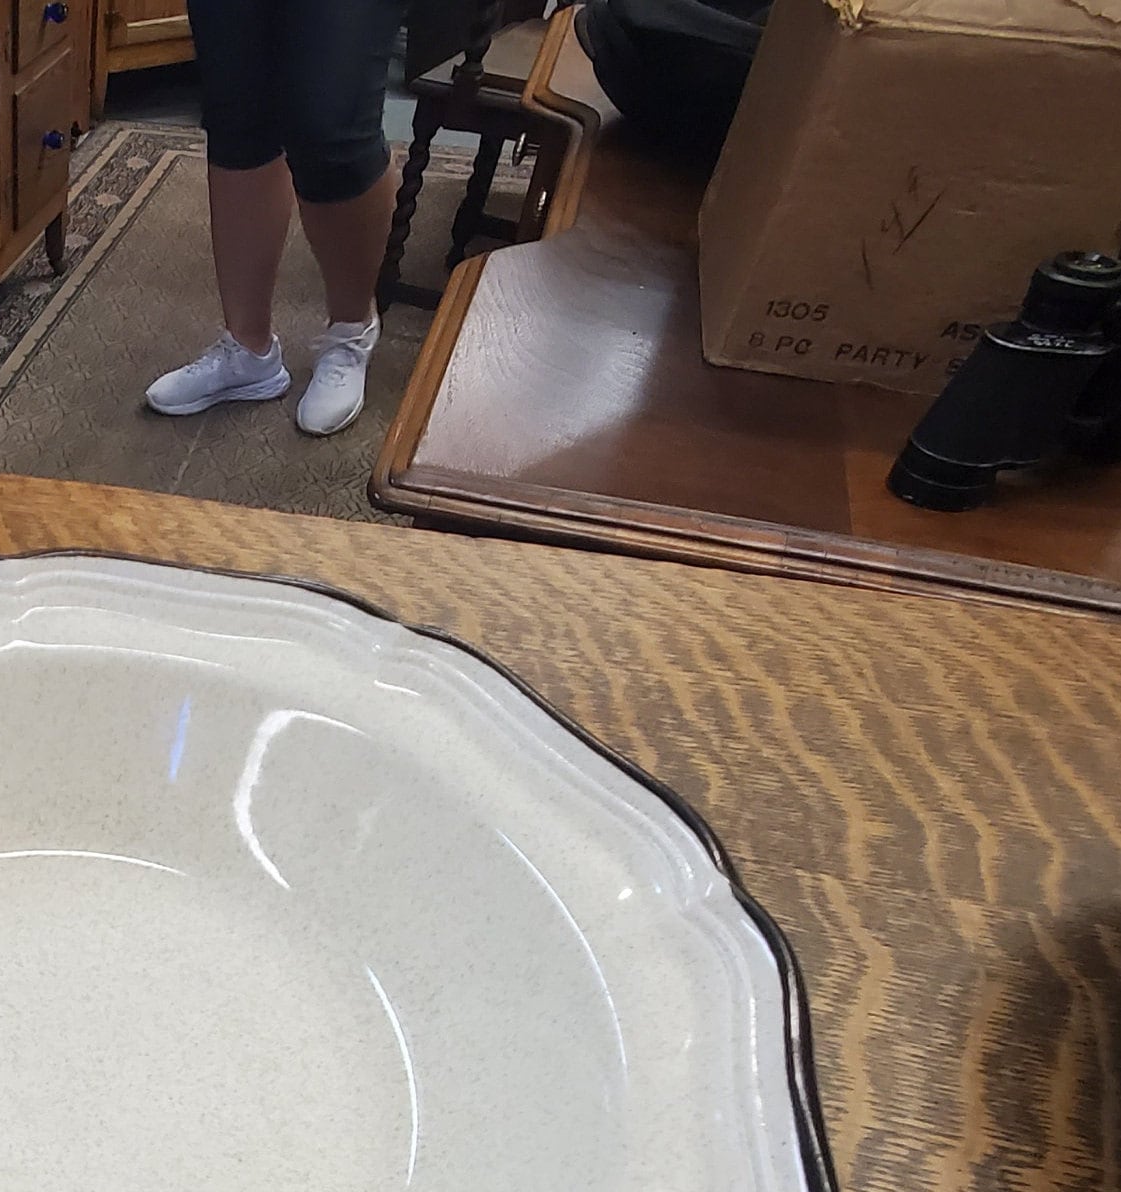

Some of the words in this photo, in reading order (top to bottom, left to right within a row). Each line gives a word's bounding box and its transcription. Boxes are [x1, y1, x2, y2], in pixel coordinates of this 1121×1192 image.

[766, 300, 830, 322] 1305
[940, 321, 981, 341] AS
[775, 335, 813, 355] PC
[835, 343, 930, 370] PARTY
